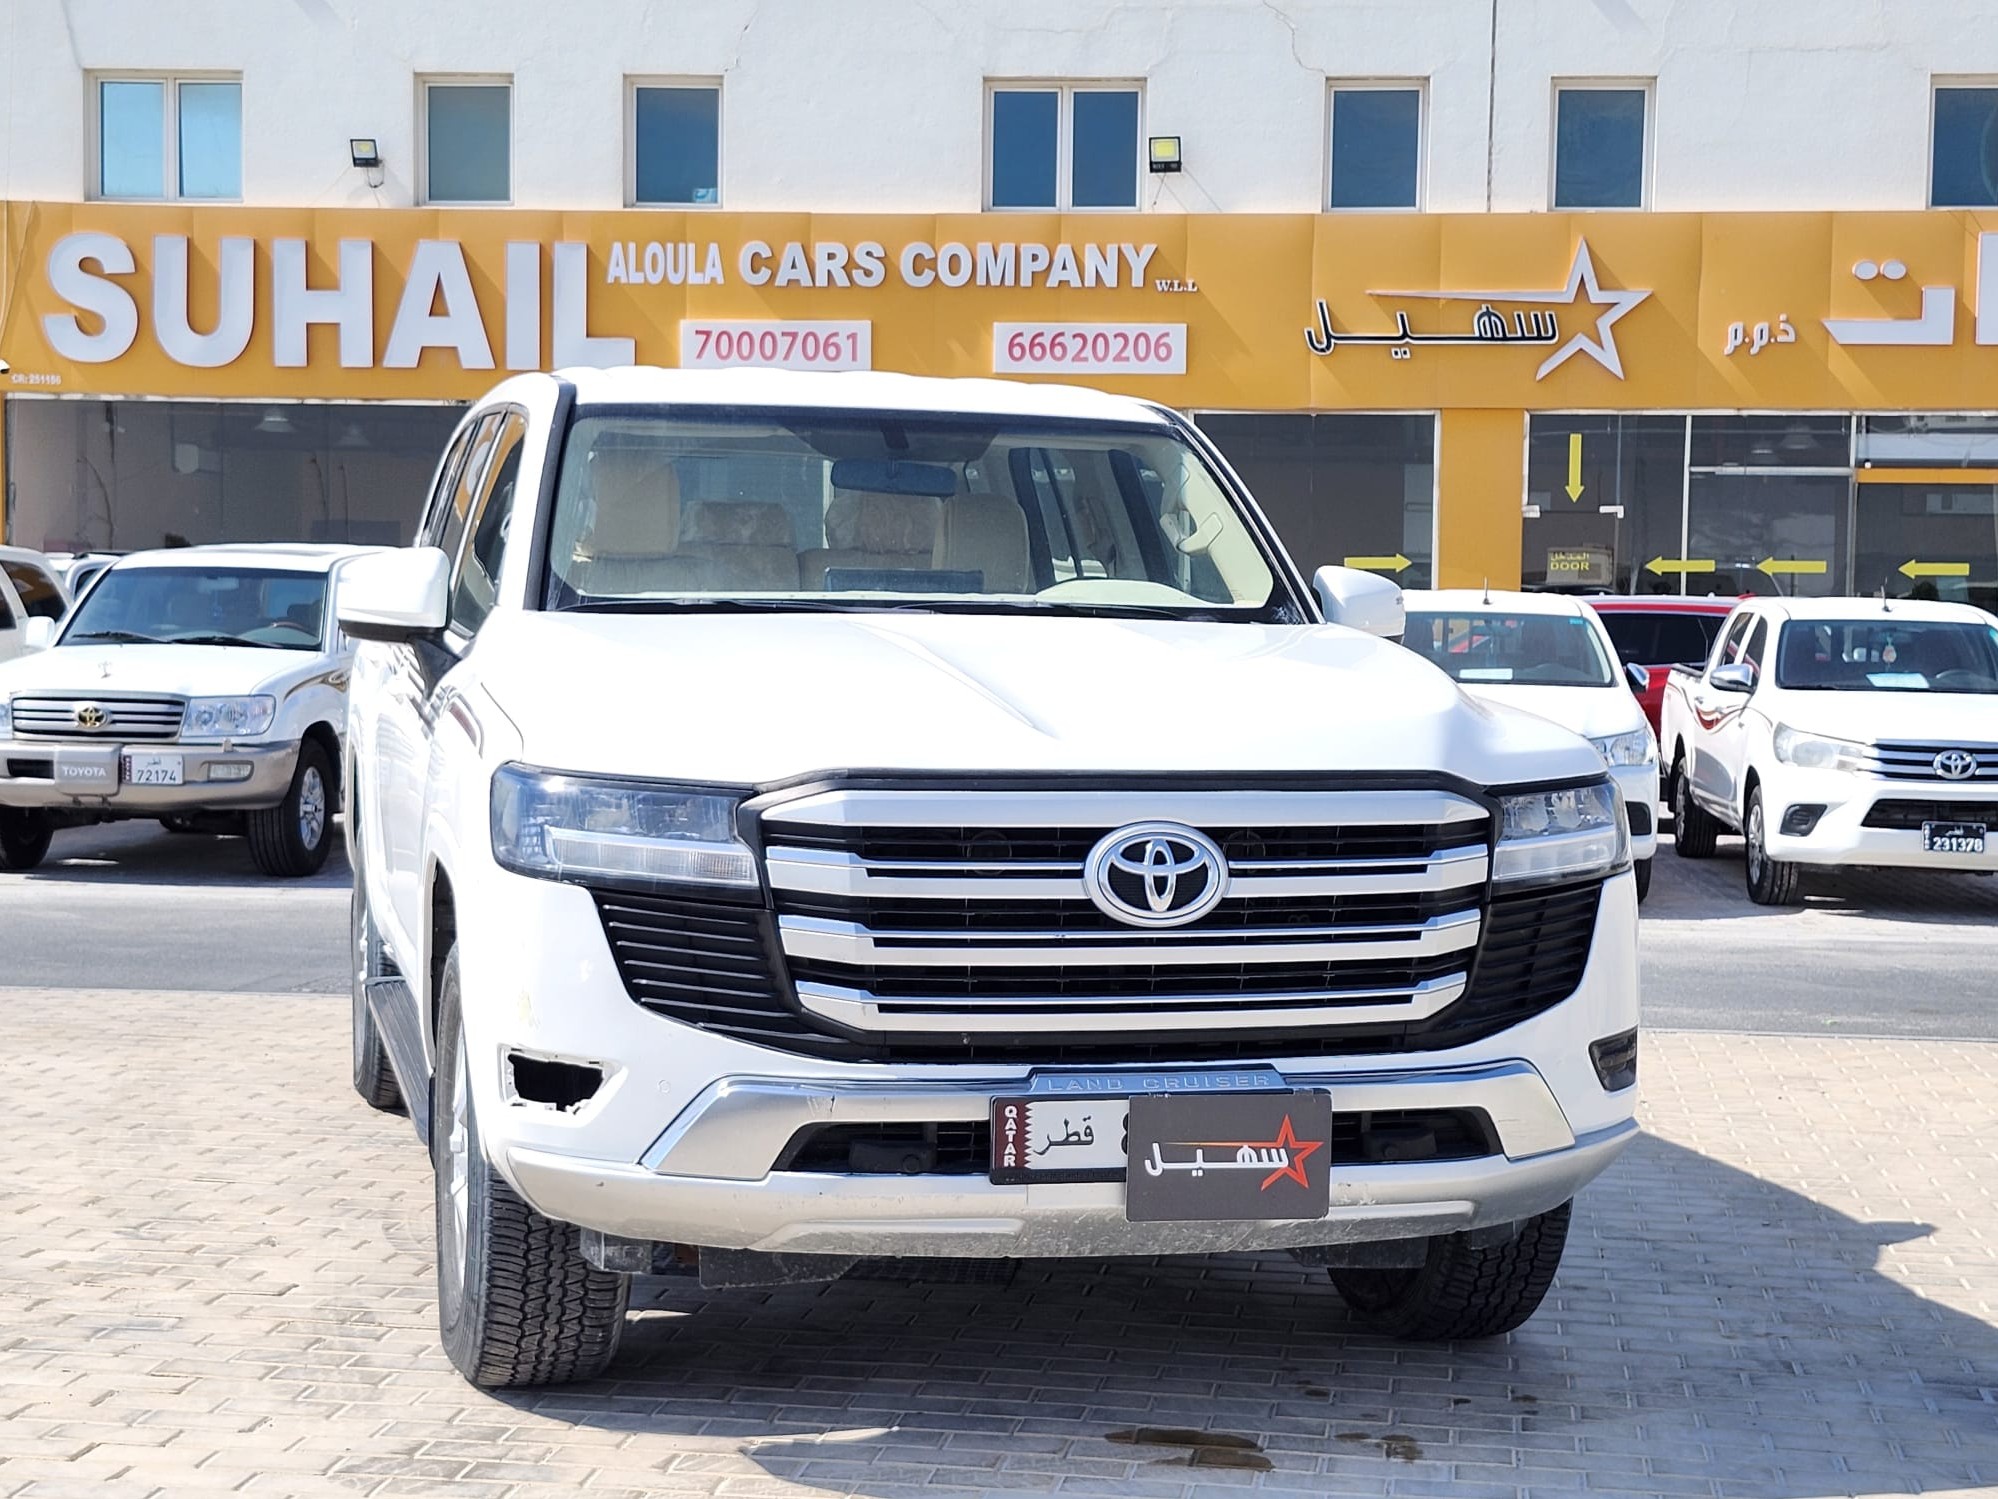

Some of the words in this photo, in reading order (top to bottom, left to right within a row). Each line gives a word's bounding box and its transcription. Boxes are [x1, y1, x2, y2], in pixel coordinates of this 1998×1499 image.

[606, 241, 725, 286] ALOULA
[739, 240, 887, 289] CARS
[900, 242, 1158, 289] COMPANY
[43, 231, 637, 371] SUHAIL
[693, 329, 861, 364] 70007061
[1006, 330, 1174, 363] 66620206
[1550, 561, 1590, 571] DOOR
[62, 766, 107, 777] TOYOTA
[136, 769, 178, 783] 72174
[1047, 1078, 1123, 1091] LAND
[1142, 1074, 1270, 1090] CRUISER
[1003, 1105, 1018, 1168] QATAR
[1033, 1115, 1096, 1156] قطر
